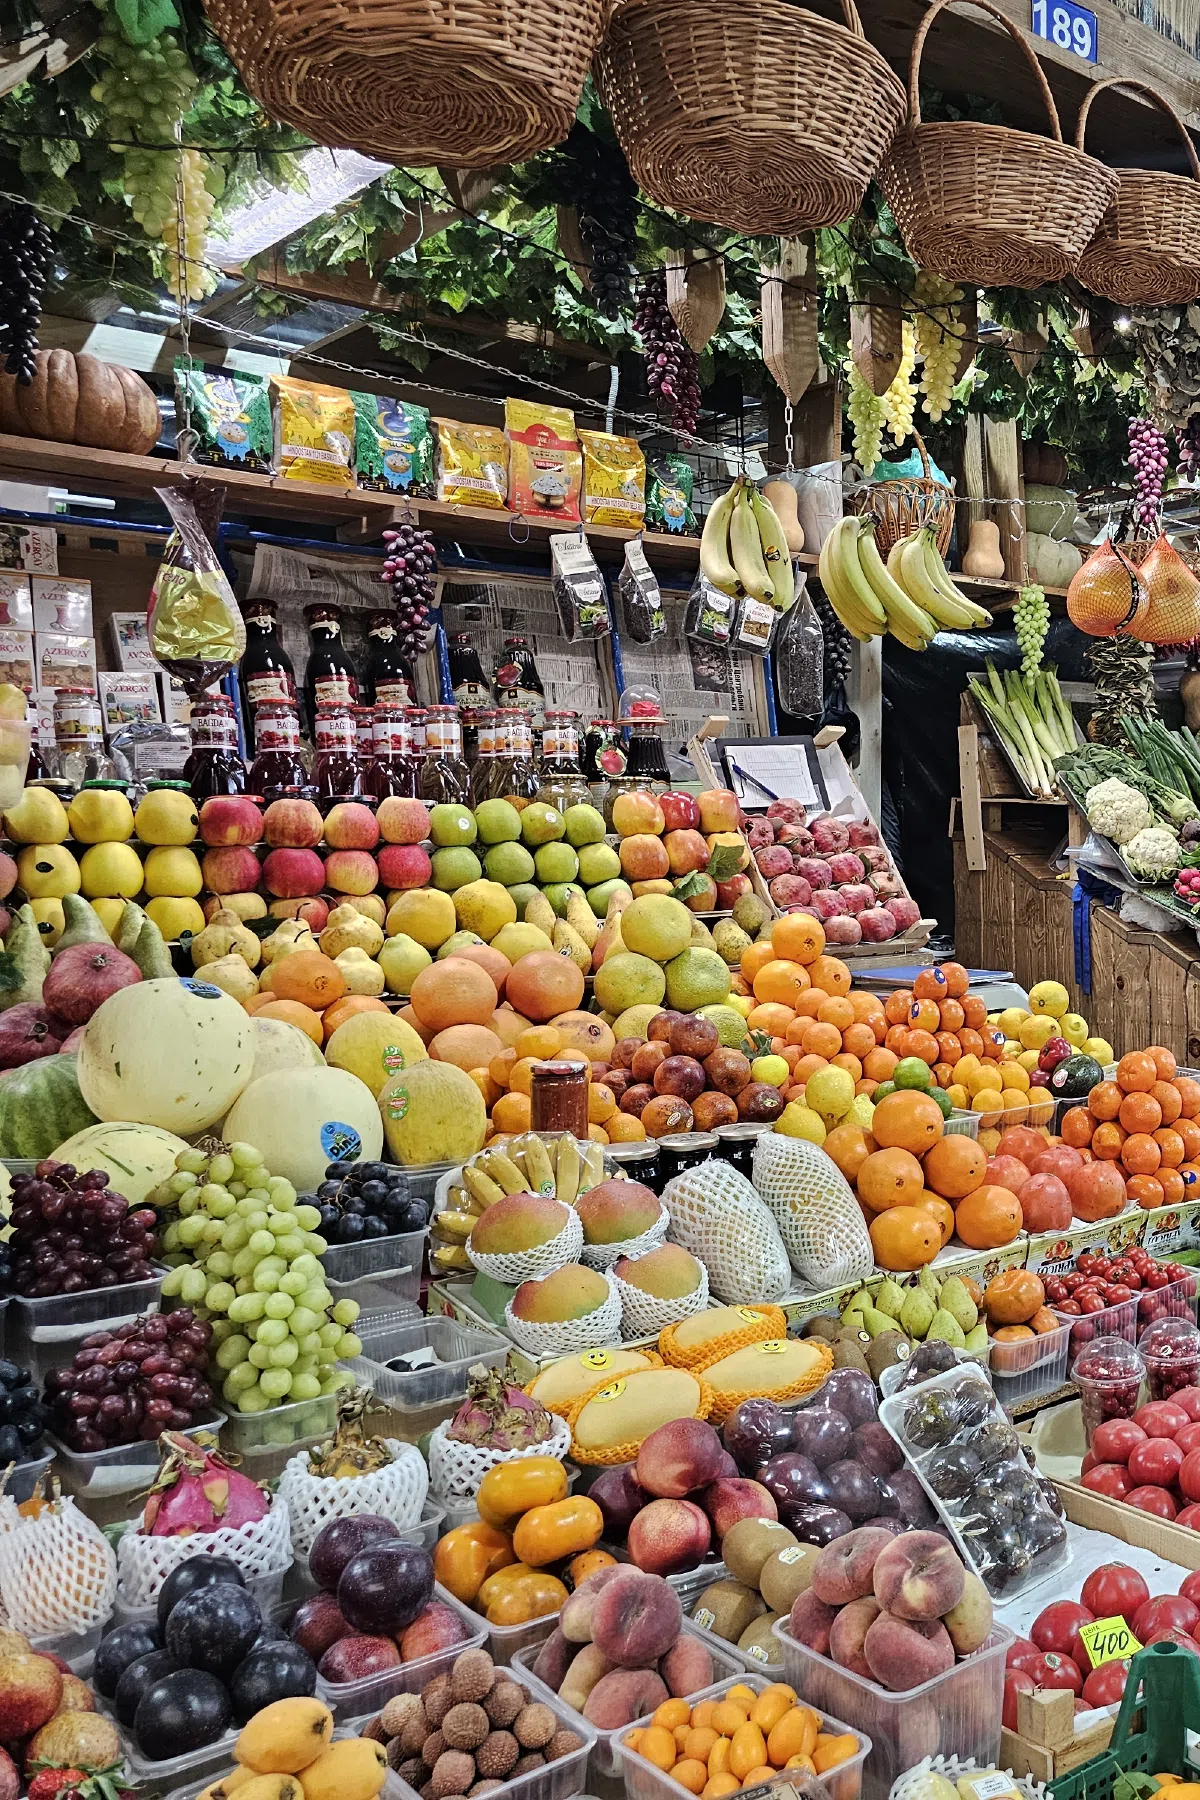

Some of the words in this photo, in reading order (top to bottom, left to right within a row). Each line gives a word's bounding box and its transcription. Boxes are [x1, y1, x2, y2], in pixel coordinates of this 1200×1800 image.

[1033, 0, 1092, 58] 189
[0, 645, 26, 654] RÇAY
[44, 648, 90, 659] AZERÇAY
[731, 649, 739, 668] ачем
[106, 685, 150, 694] AZERÇAY
[732, 669, 745, 711] Центробанк
[329, 1133, 357, 1157] Dino
[1093, 1630, 1129, 1661] 400
